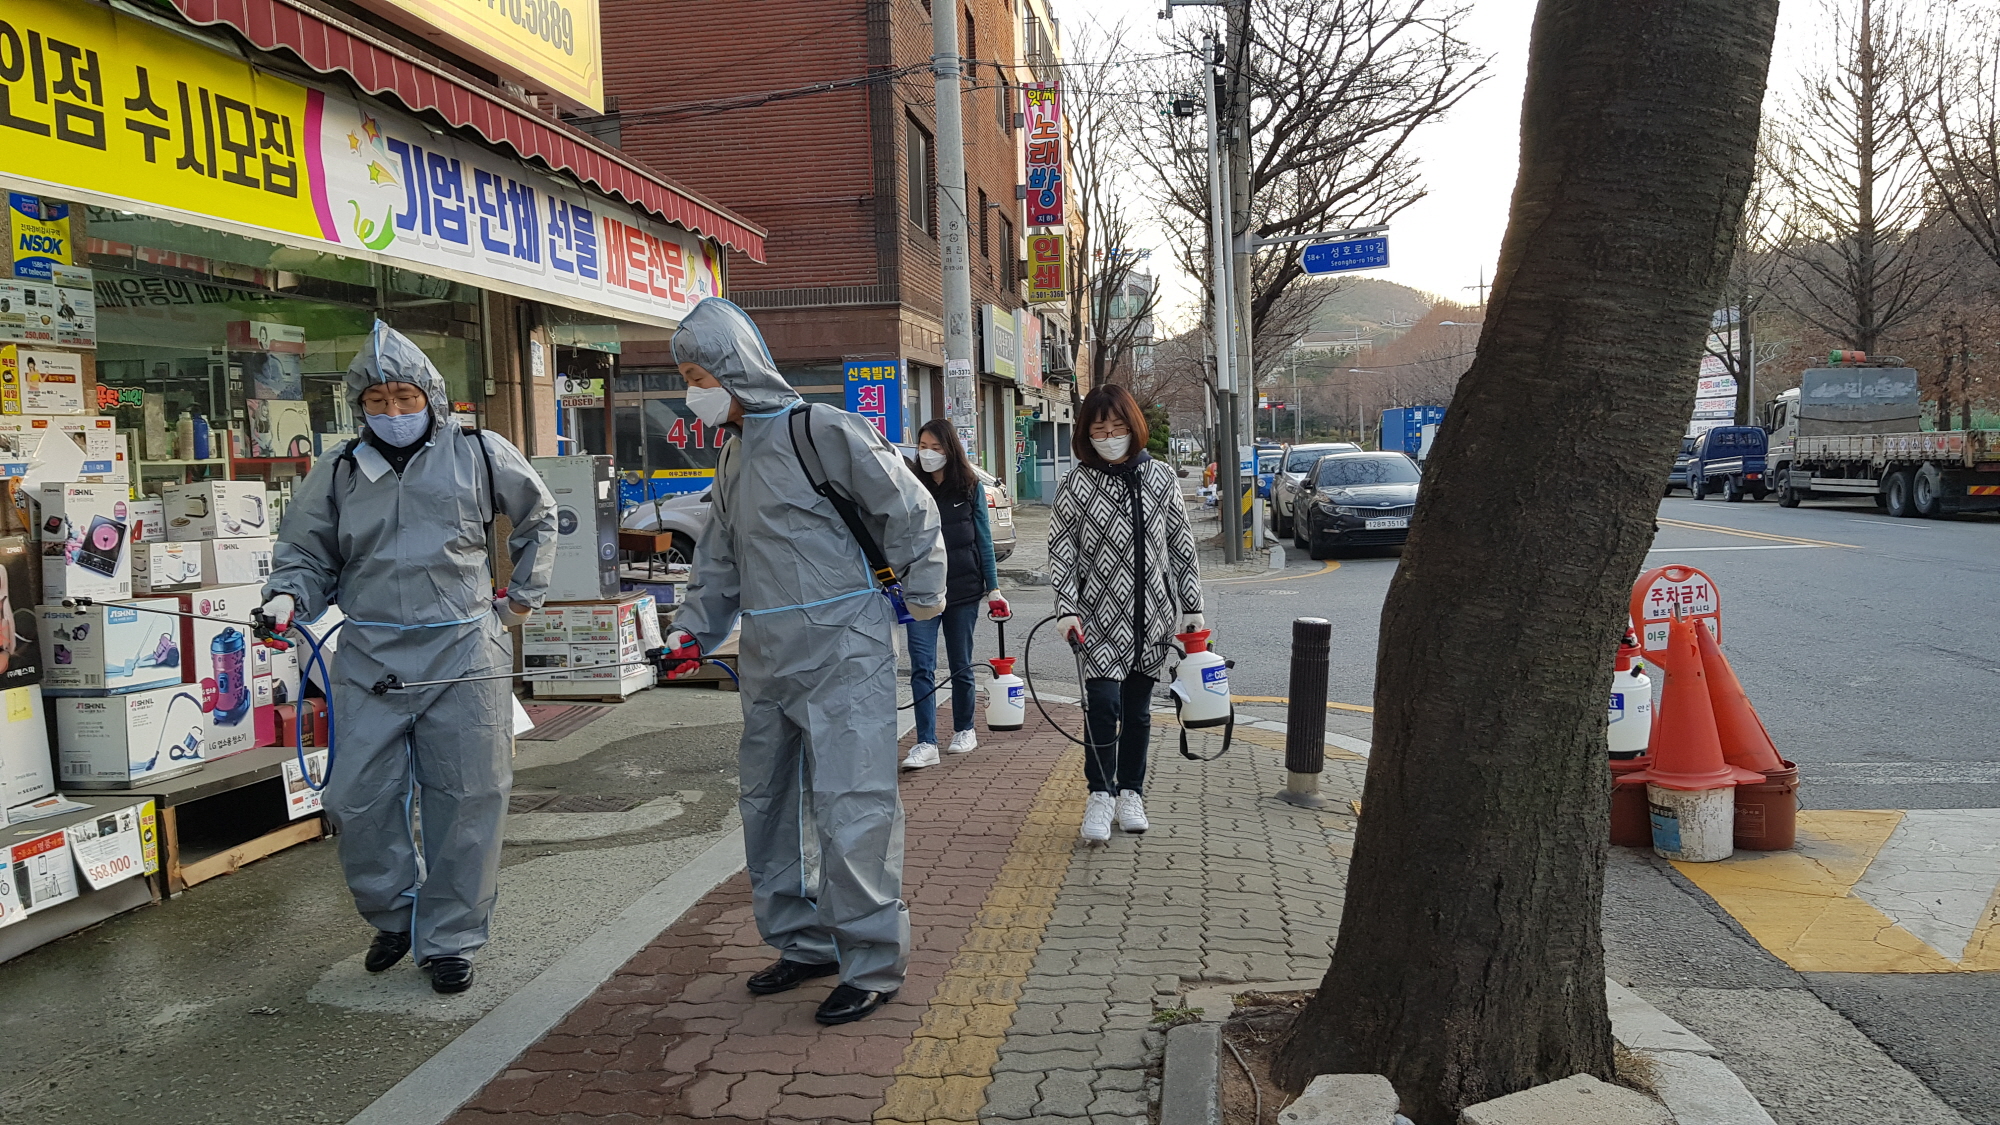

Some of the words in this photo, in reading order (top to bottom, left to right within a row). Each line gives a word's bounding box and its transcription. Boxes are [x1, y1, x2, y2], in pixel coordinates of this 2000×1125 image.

[124, 65, 298, 199] 수시모집
[1029, 114, 1061, 208] 노래방
[1038, 214, 1053, 224] 지하
[19, 233, 64, 255] NSOK
[547, 195, 599, 281] 선물
[602, 216, 686, 305] 세트전문
[1033, 238, 1060, 290] 인쇄
[1306, 254, 1316, 262] 38
[1331, 257, 1366, 267] Seongho-ro
[1366, 255, 1386, 264] 19-gil
[29, 268, 51, 277] telecom
[848, 366, 896, 381] 신축빌라
[4, 400, 19, 412] 50%
[562, 399, 593, 407] CLOSED
[1651, 583, 1709, 607] 주차금지
[213, 599, 226, 611] LG
[208, 741, 217, 751] LG
[22, 783, 44, 794] SEGWAY
[88, 854, 131, 882] 568,000
